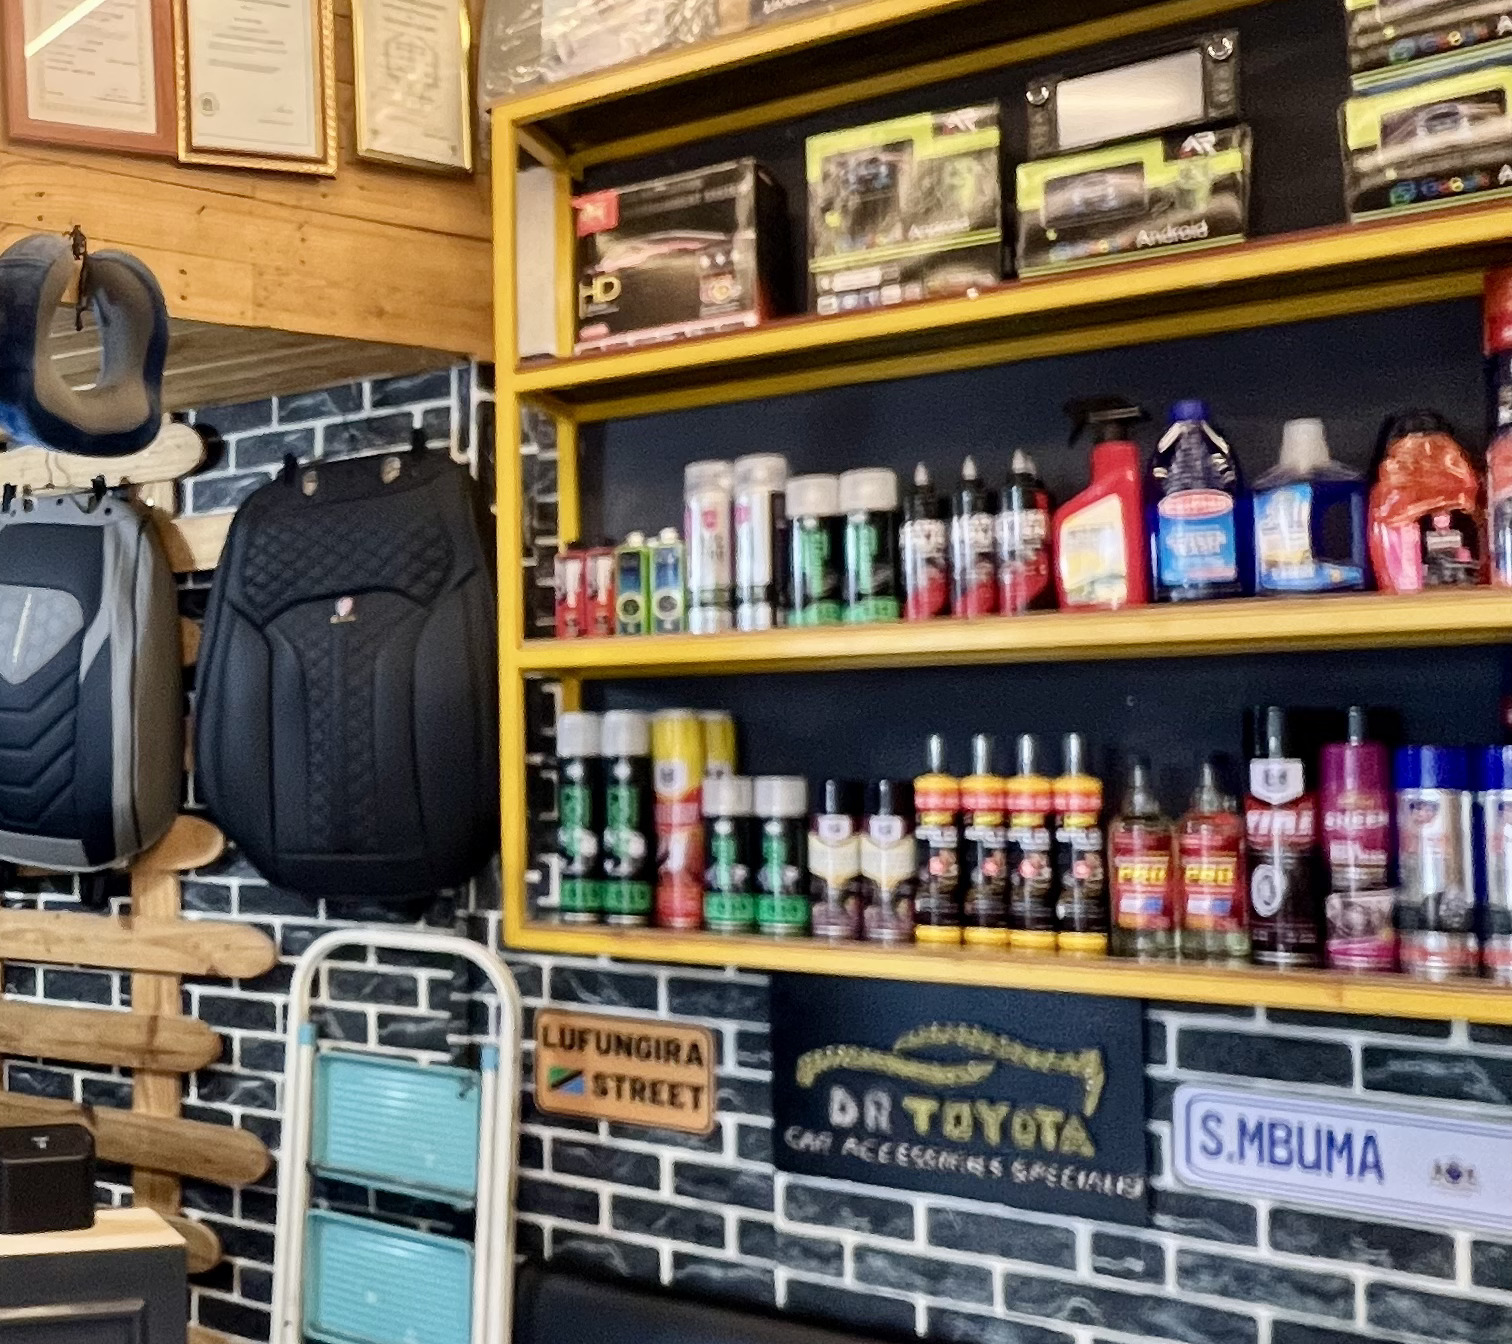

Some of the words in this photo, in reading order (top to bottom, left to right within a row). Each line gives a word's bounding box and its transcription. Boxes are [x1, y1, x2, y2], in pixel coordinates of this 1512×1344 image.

[1137, 220, 1209, 248] Android
[542, 1025, 704, 1068] LUFUNGIRA
[593, 1071, 704, 1111] STREET
[784, 1125, 833, 1154] CAR
[829, 1085, 892, 1133] DR
[902, 1096, 1095, 1157] TOYOTA
[1199, 1109, 1385, 1186] S.MBUMA
